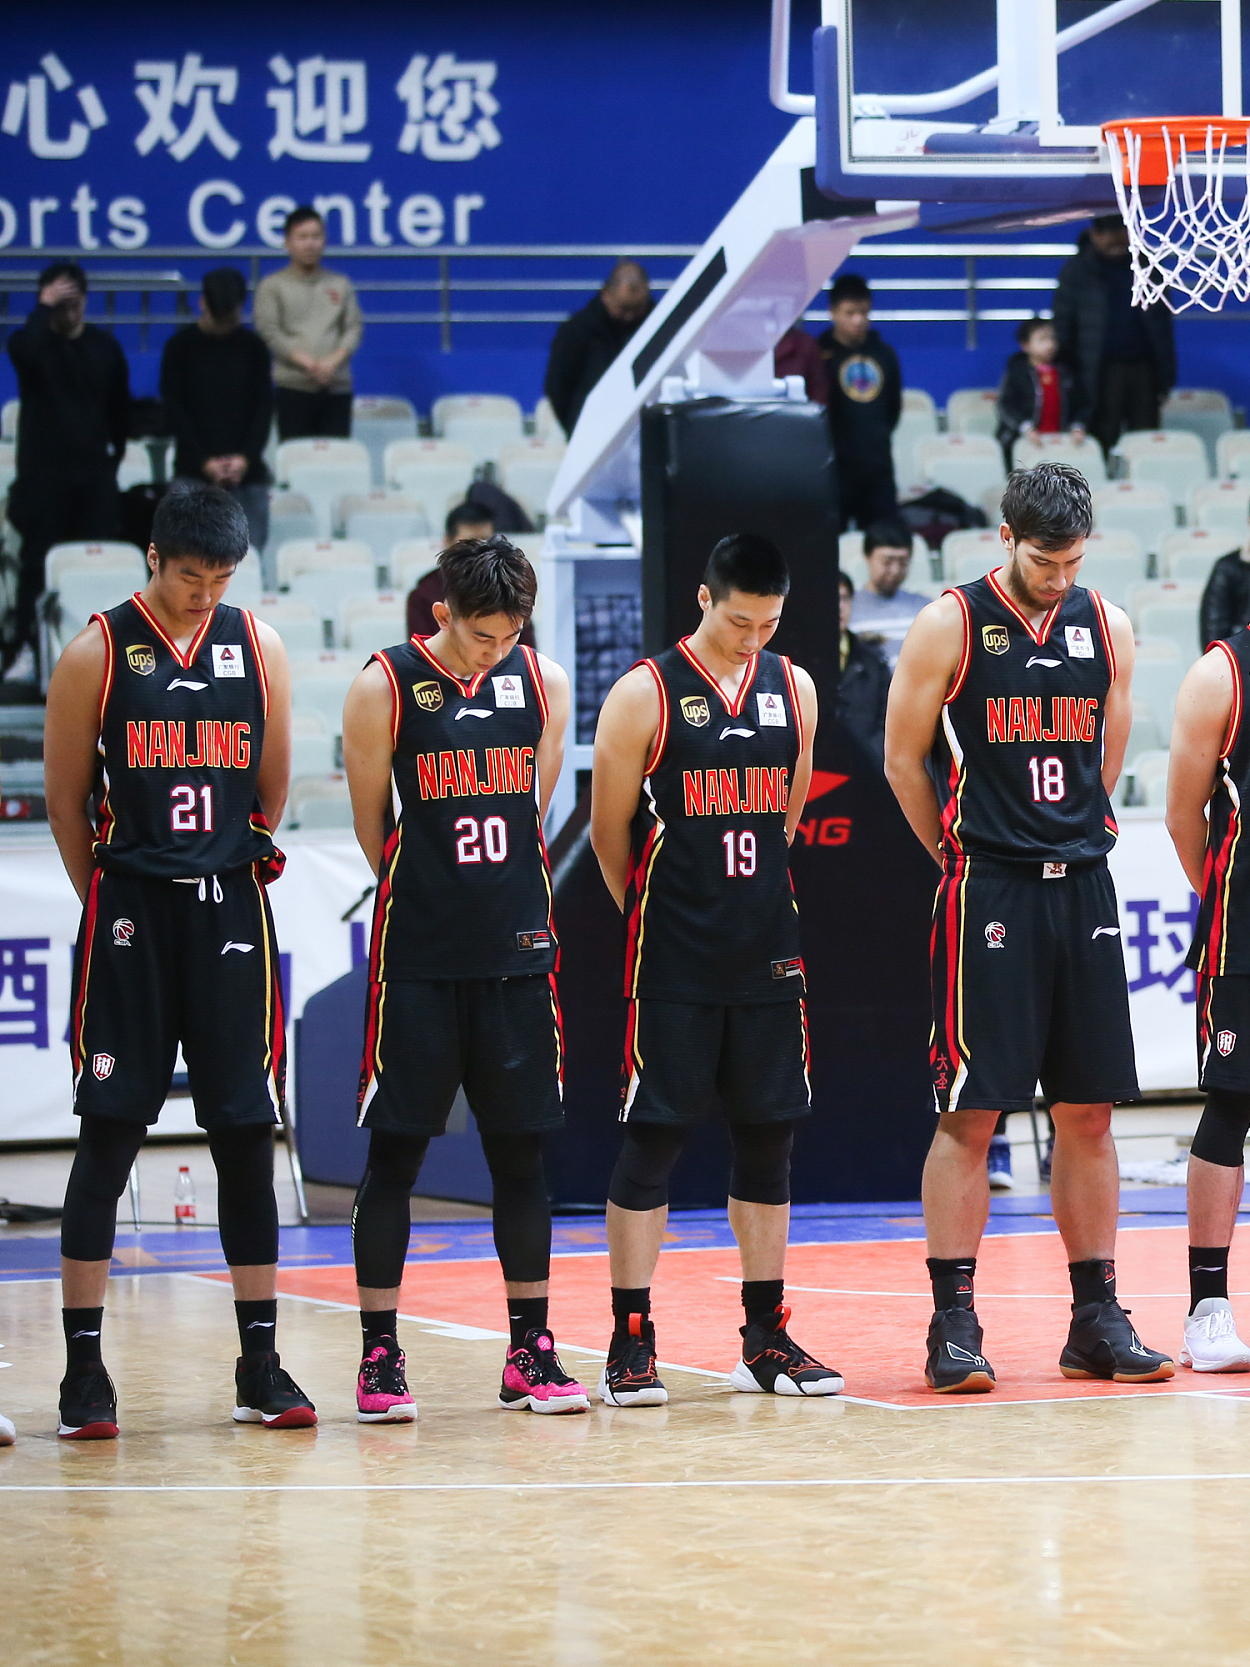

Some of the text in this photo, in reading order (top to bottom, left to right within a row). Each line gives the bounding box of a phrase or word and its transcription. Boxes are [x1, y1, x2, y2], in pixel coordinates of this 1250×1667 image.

[1, 52, 502, 163] 心欢迎您
[189, 180, 485, 249] Center
[130, 652, 154, 671] ups
[985, 633, 1008, 651] ups
[417, 689, 441, 708] ups
[683, 705, 707, 722] ups
[986, 696, 1099, 743] NANJING
[126, 720, 251, 769] NANJING
[416, 746, 534, 801] NANJING
[682, 766, 789, 817] NANJING
[1028, 756, 1066, 802] 18
[170, 784, 213, 832] 21
[454, 816, 508, 864] 20
[722, 829, 758, 877] 19
